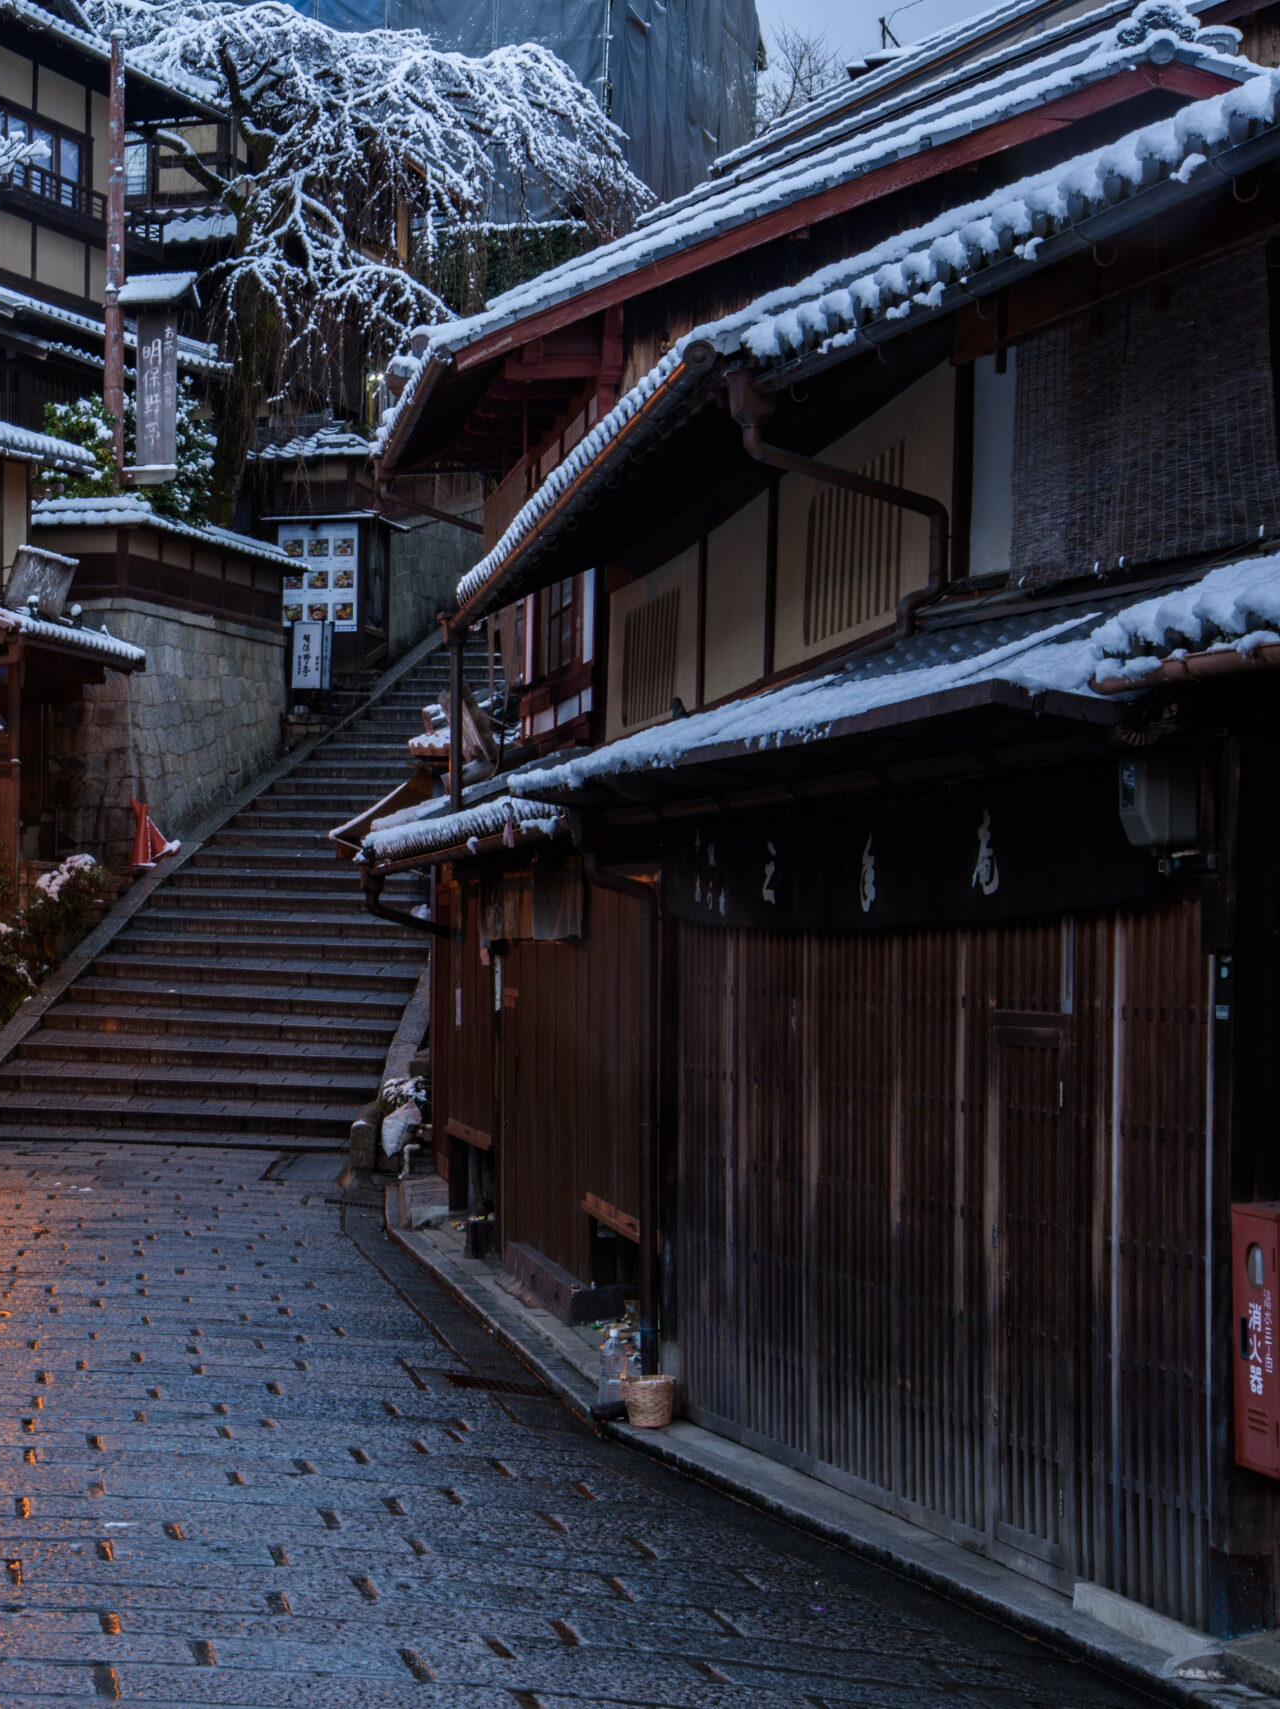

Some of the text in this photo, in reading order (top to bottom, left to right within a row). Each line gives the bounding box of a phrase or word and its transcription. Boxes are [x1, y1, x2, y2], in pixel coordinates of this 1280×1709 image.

[142, 338, 162, 447] 明保野亭
[1248, 1302, 1264, 1395] 消火器
